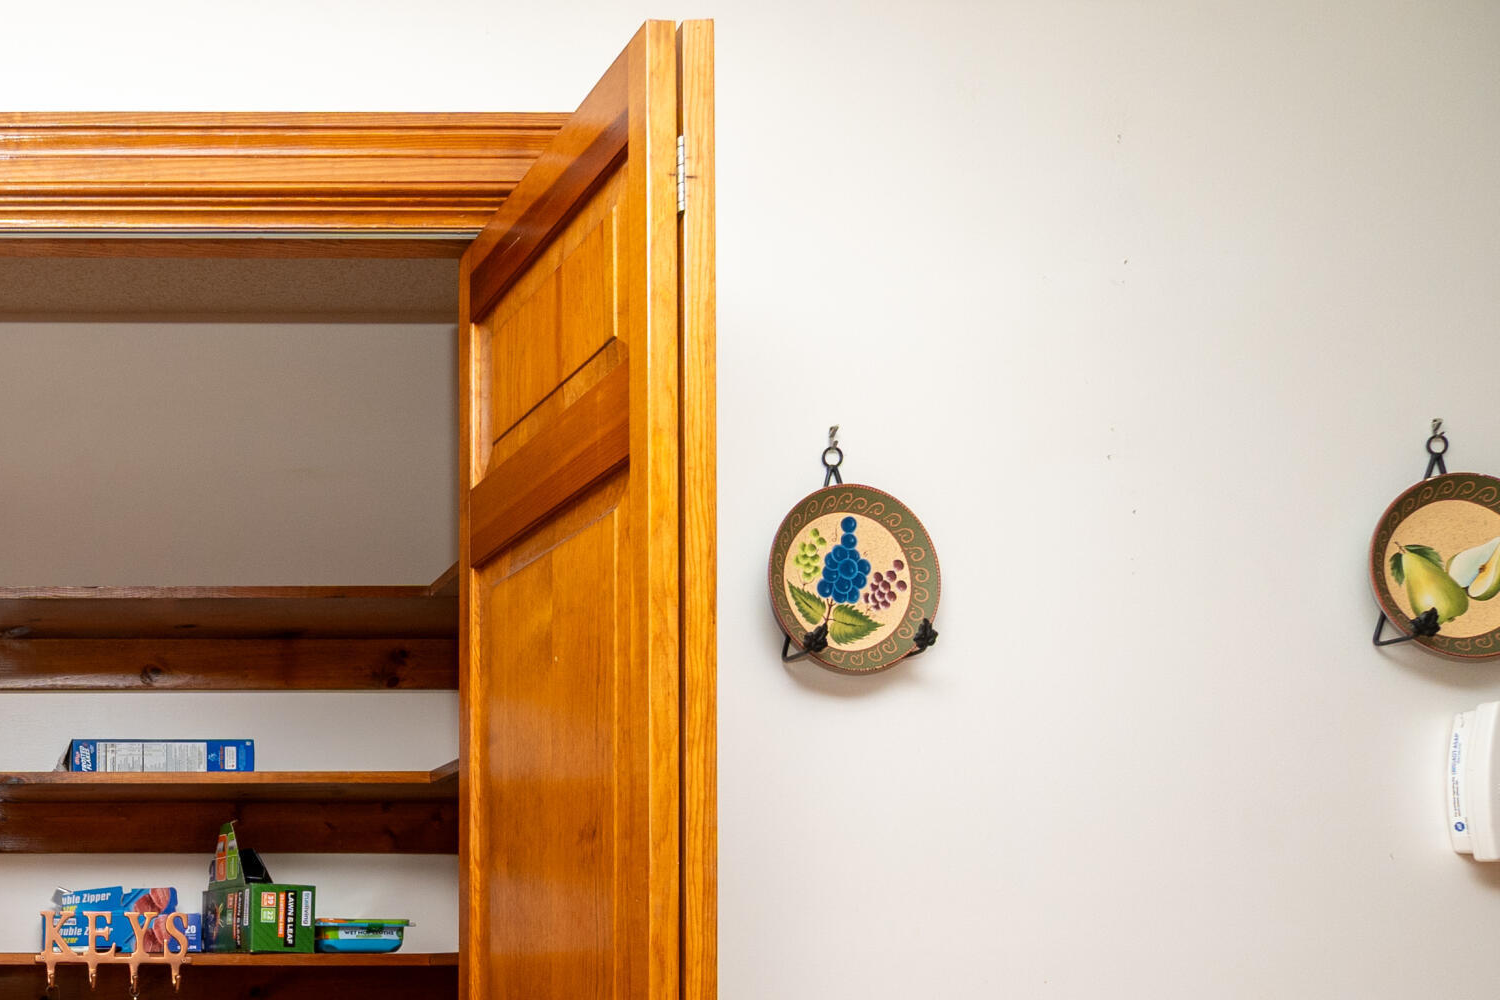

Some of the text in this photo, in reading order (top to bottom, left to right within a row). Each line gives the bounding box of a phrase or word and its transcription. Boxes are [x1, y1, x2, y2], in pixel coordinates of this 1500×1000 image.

[61, 892, 111, 905] uble Zipper
[287, 892, 295, 916] LAWN
[40, 911, 188, 955] KEYS
[59, 926, 82, 936] ouble
[286, 923, 294, 944] LEAF
